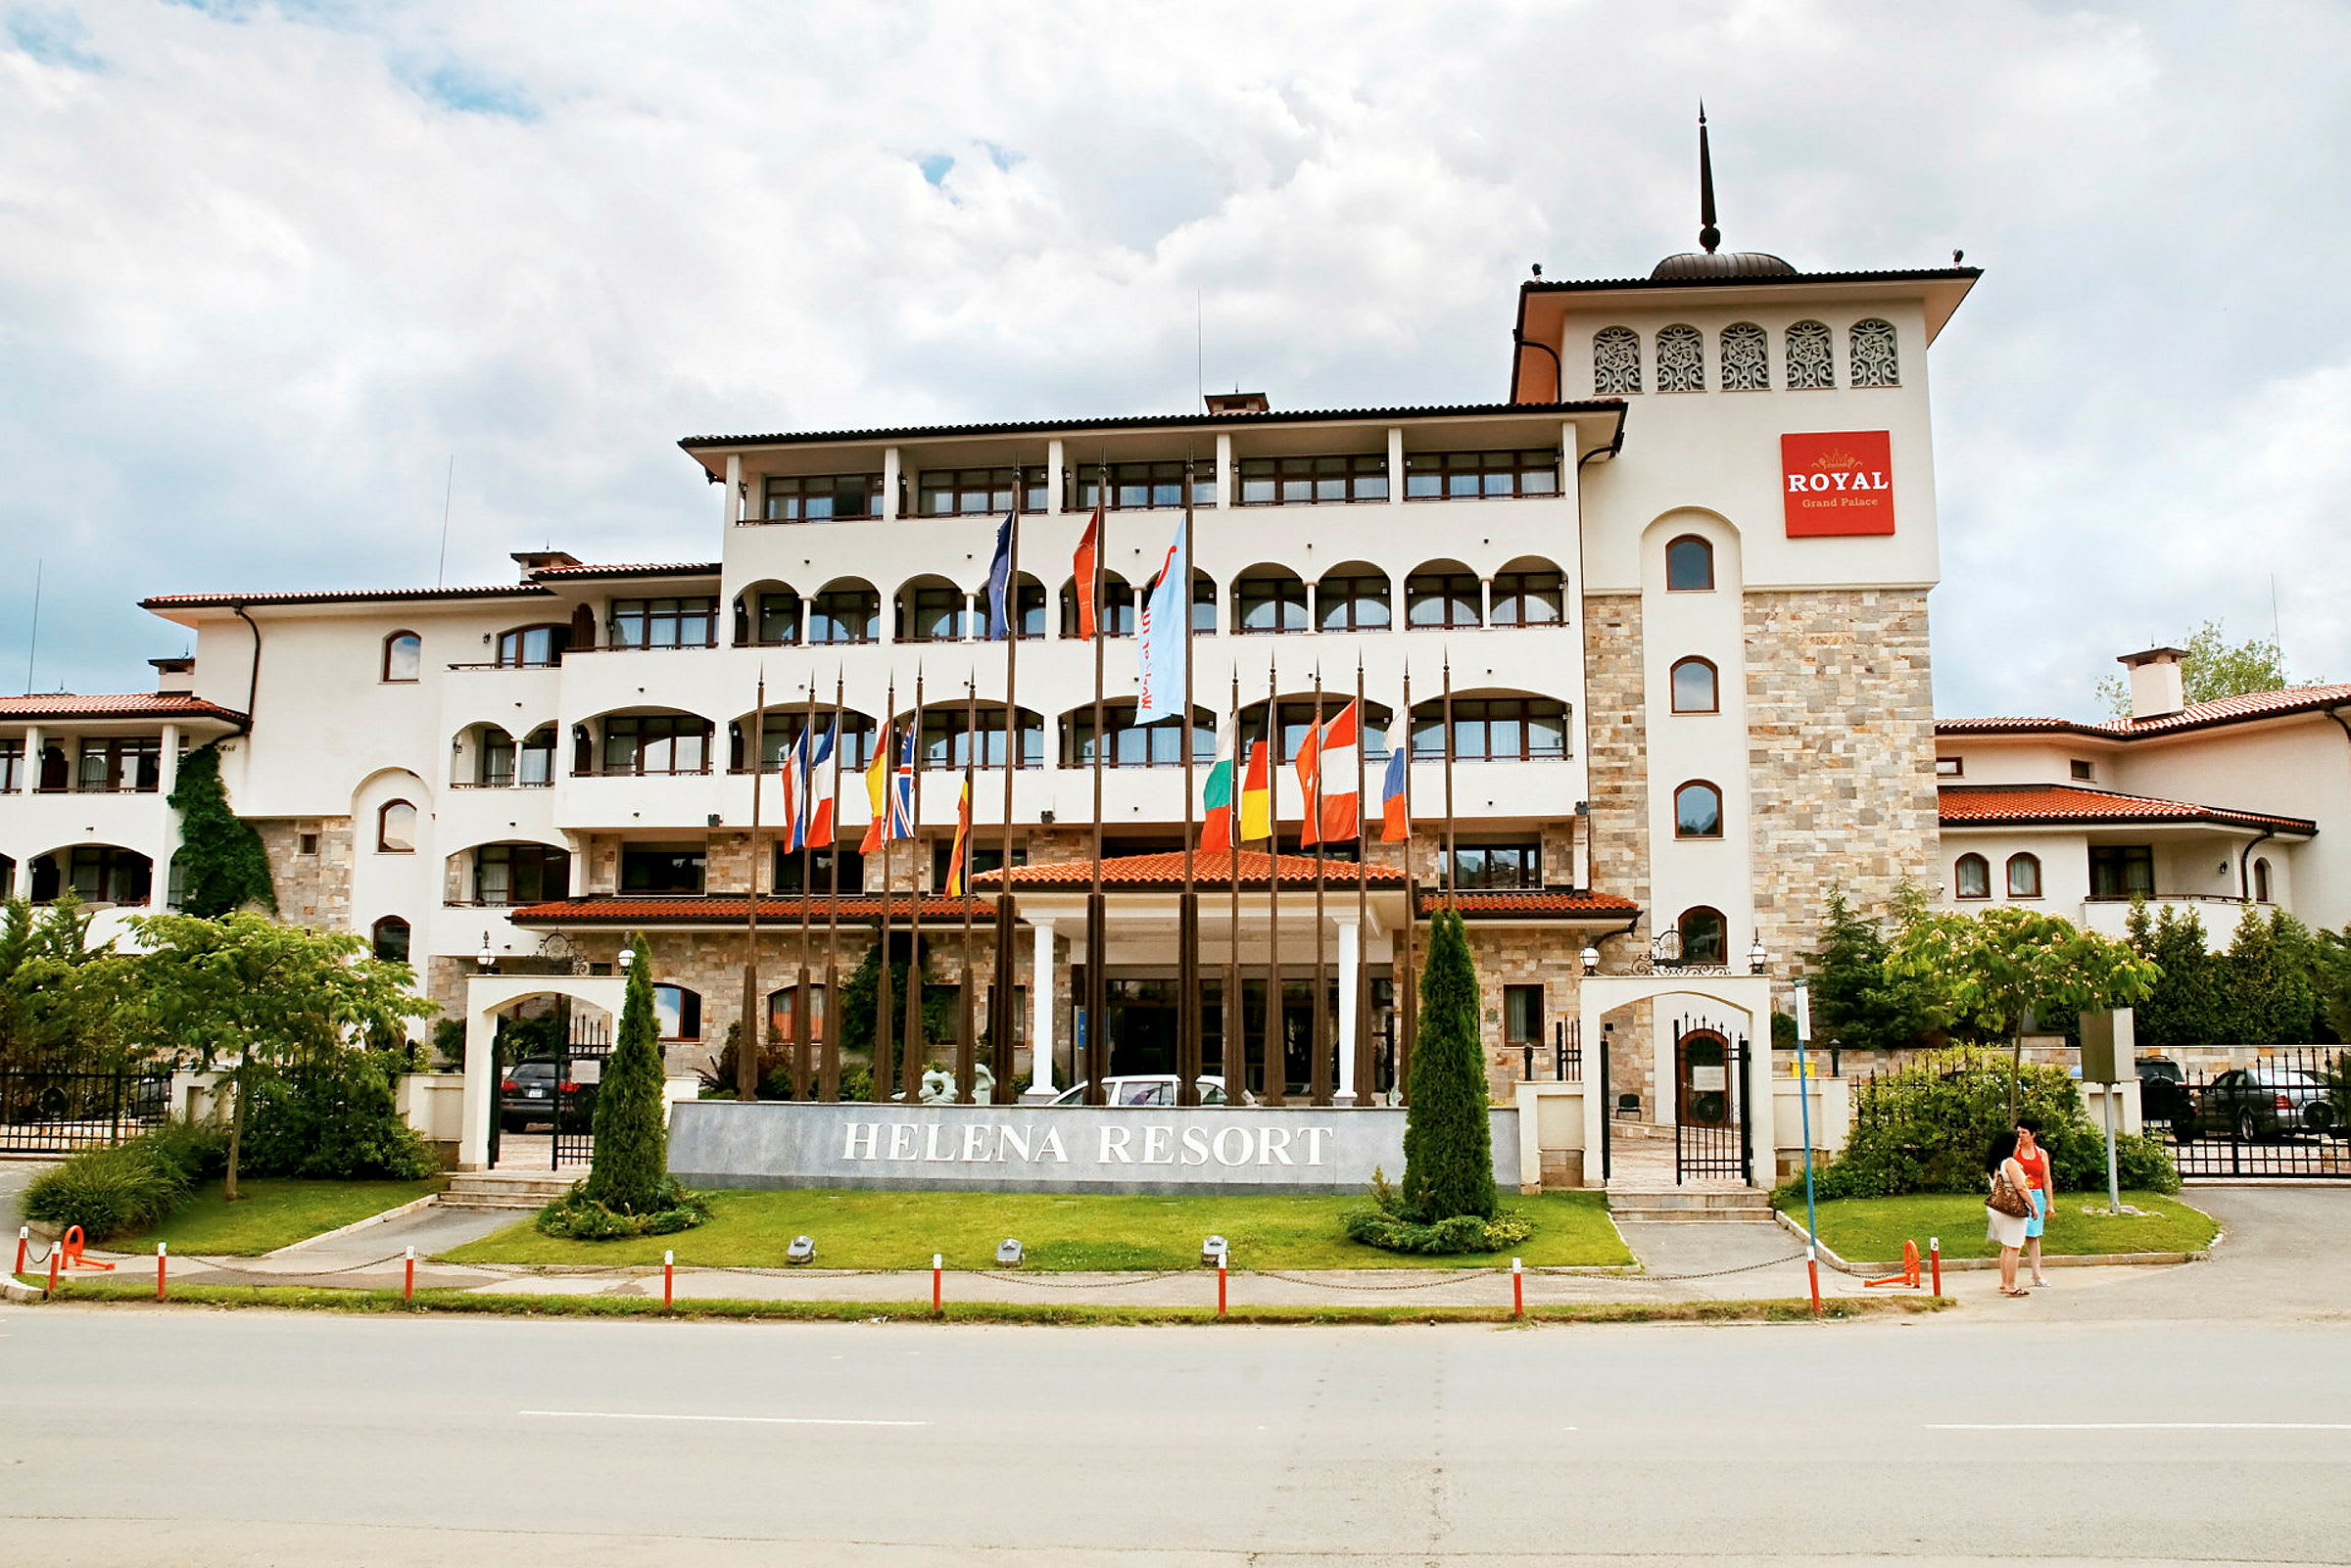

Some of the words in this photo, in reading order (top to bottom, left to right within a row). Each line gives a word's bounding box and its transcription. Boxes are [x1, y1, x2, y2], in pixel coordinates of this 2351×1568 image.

[1788, 471, 1889, 493] ROYAL
[1802, 499, 1838, 508] Grand
[1841, 498, 1879, 506] Palace
[841, 1122, 1069, 1164] HELENA
[1097, 1125, 1334, 1166] RESORT
